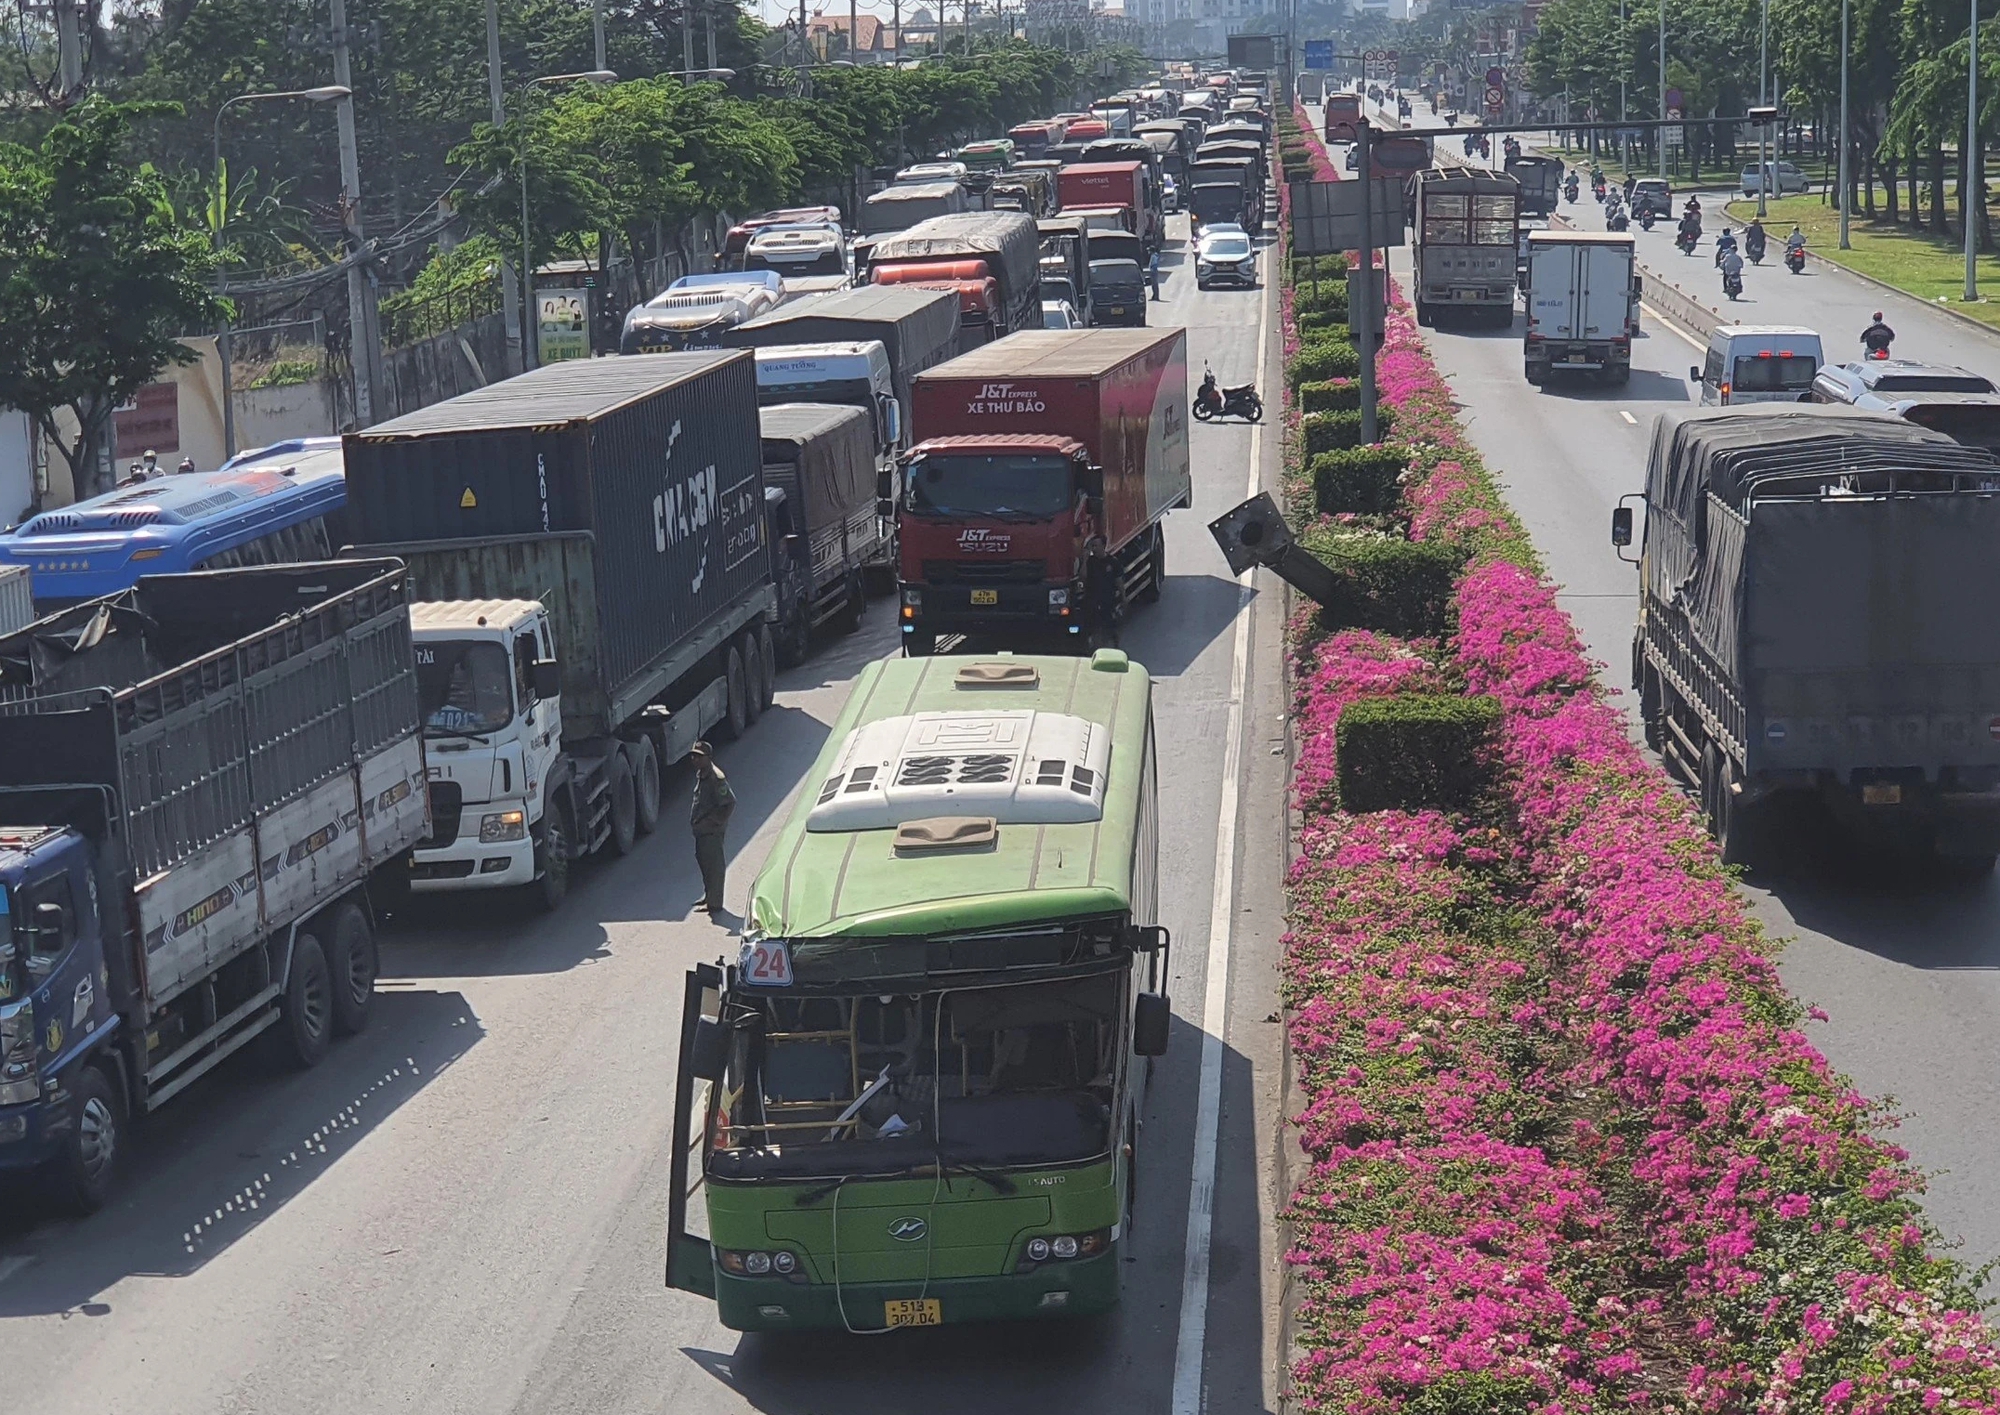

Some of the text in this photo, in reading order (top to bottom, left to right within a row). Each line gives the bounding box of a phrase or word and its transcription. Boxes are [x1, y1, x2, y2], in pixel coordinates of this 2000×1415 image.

[636, 344, 673, 354] VIP
[764, 363, 789, 372] QUANG
[974, 384, 1015, 399] J&T
[967, 399, 1046, 414] XE THƯ BÁO
[537, 453, 547, 499] CMAU
[653, 483, 689, 552] CMA
[956, 529, 991, 541] J&T
[959, 542, 1008, 552] ISUZU
[186, 896, 220, 927] HINO
[753, 947, 785, 978] 24
[900, 1301, 925, 1313] 51B
